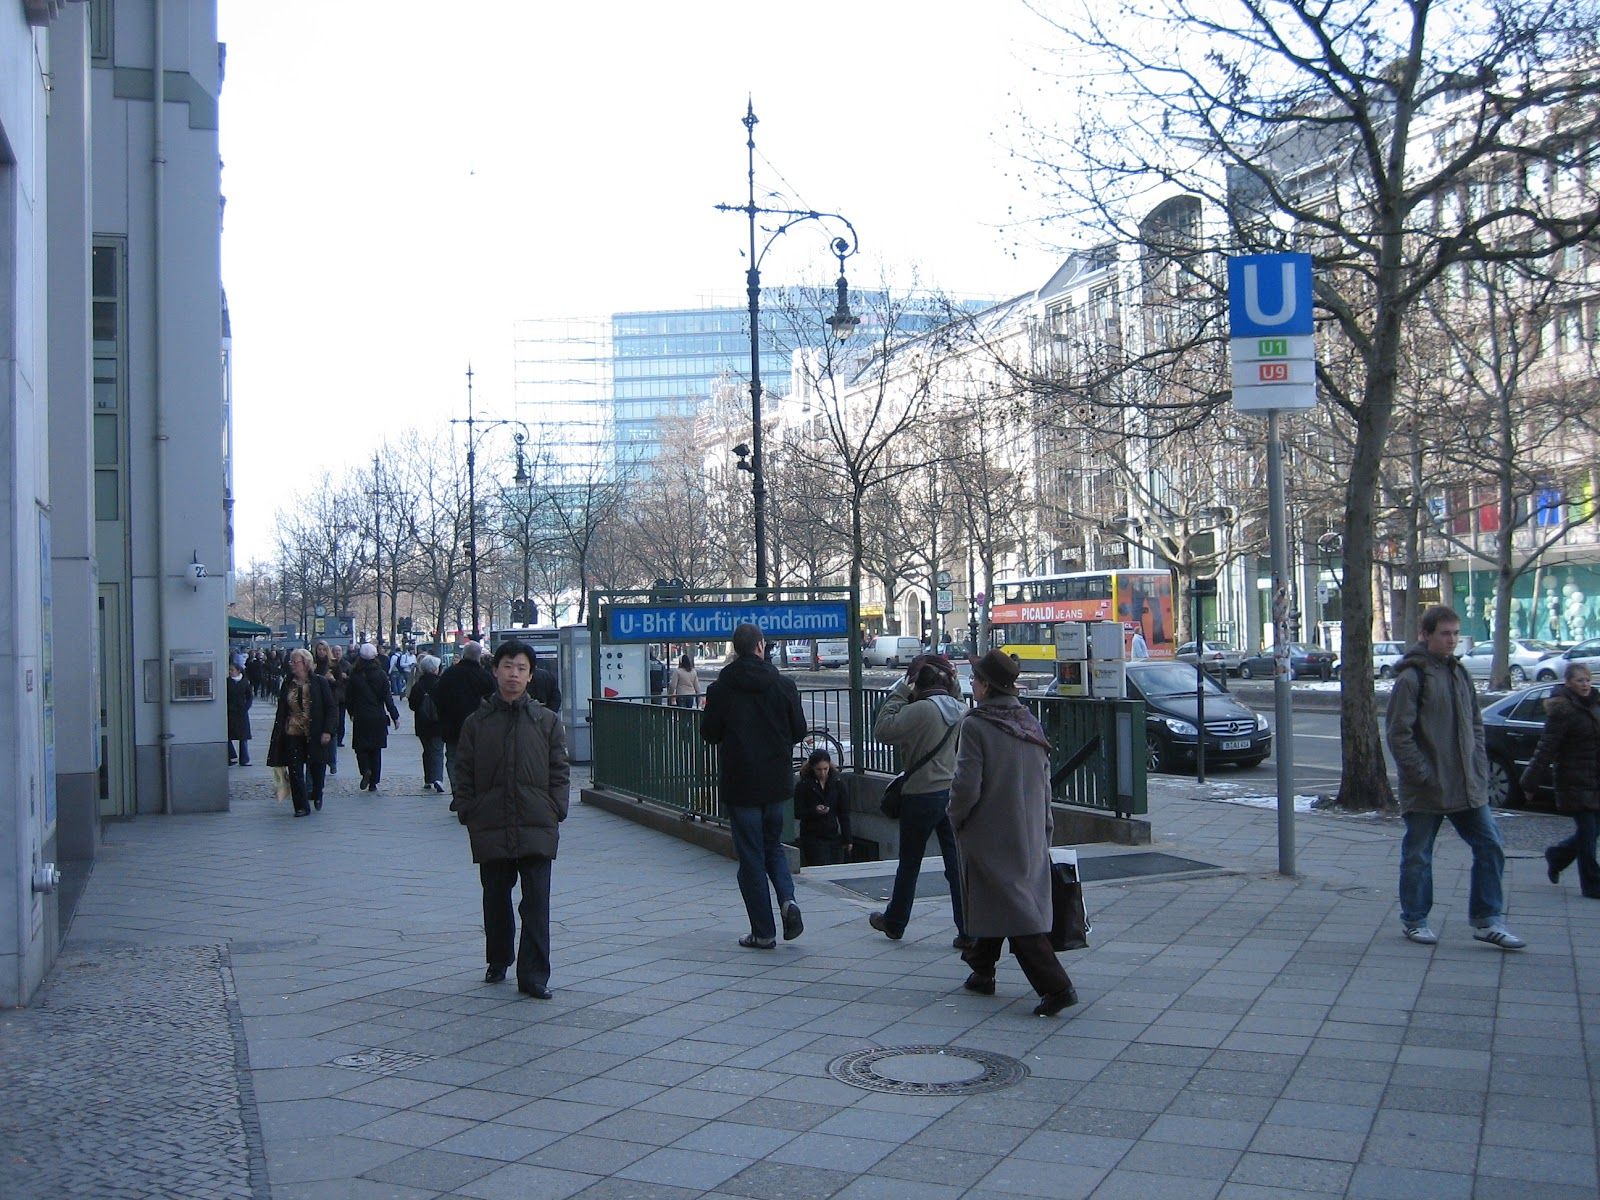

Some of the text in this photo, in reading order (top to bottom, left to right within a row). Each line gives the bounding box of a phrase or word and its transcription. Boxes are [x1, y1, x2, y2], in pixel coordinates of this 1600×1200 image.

[1244, 262, 1296, 326] U
[1262, 342, 1283, 354] U1
[1262, 365, 1285, 379] U9
[195, 566, 208, 578] 23
[1021, 607, 1054, 621] PICALDI
[1055, 609, 1083, 619] JEANS
[620, 609, 839, 634] U-Bhf Kurfürstendamm
